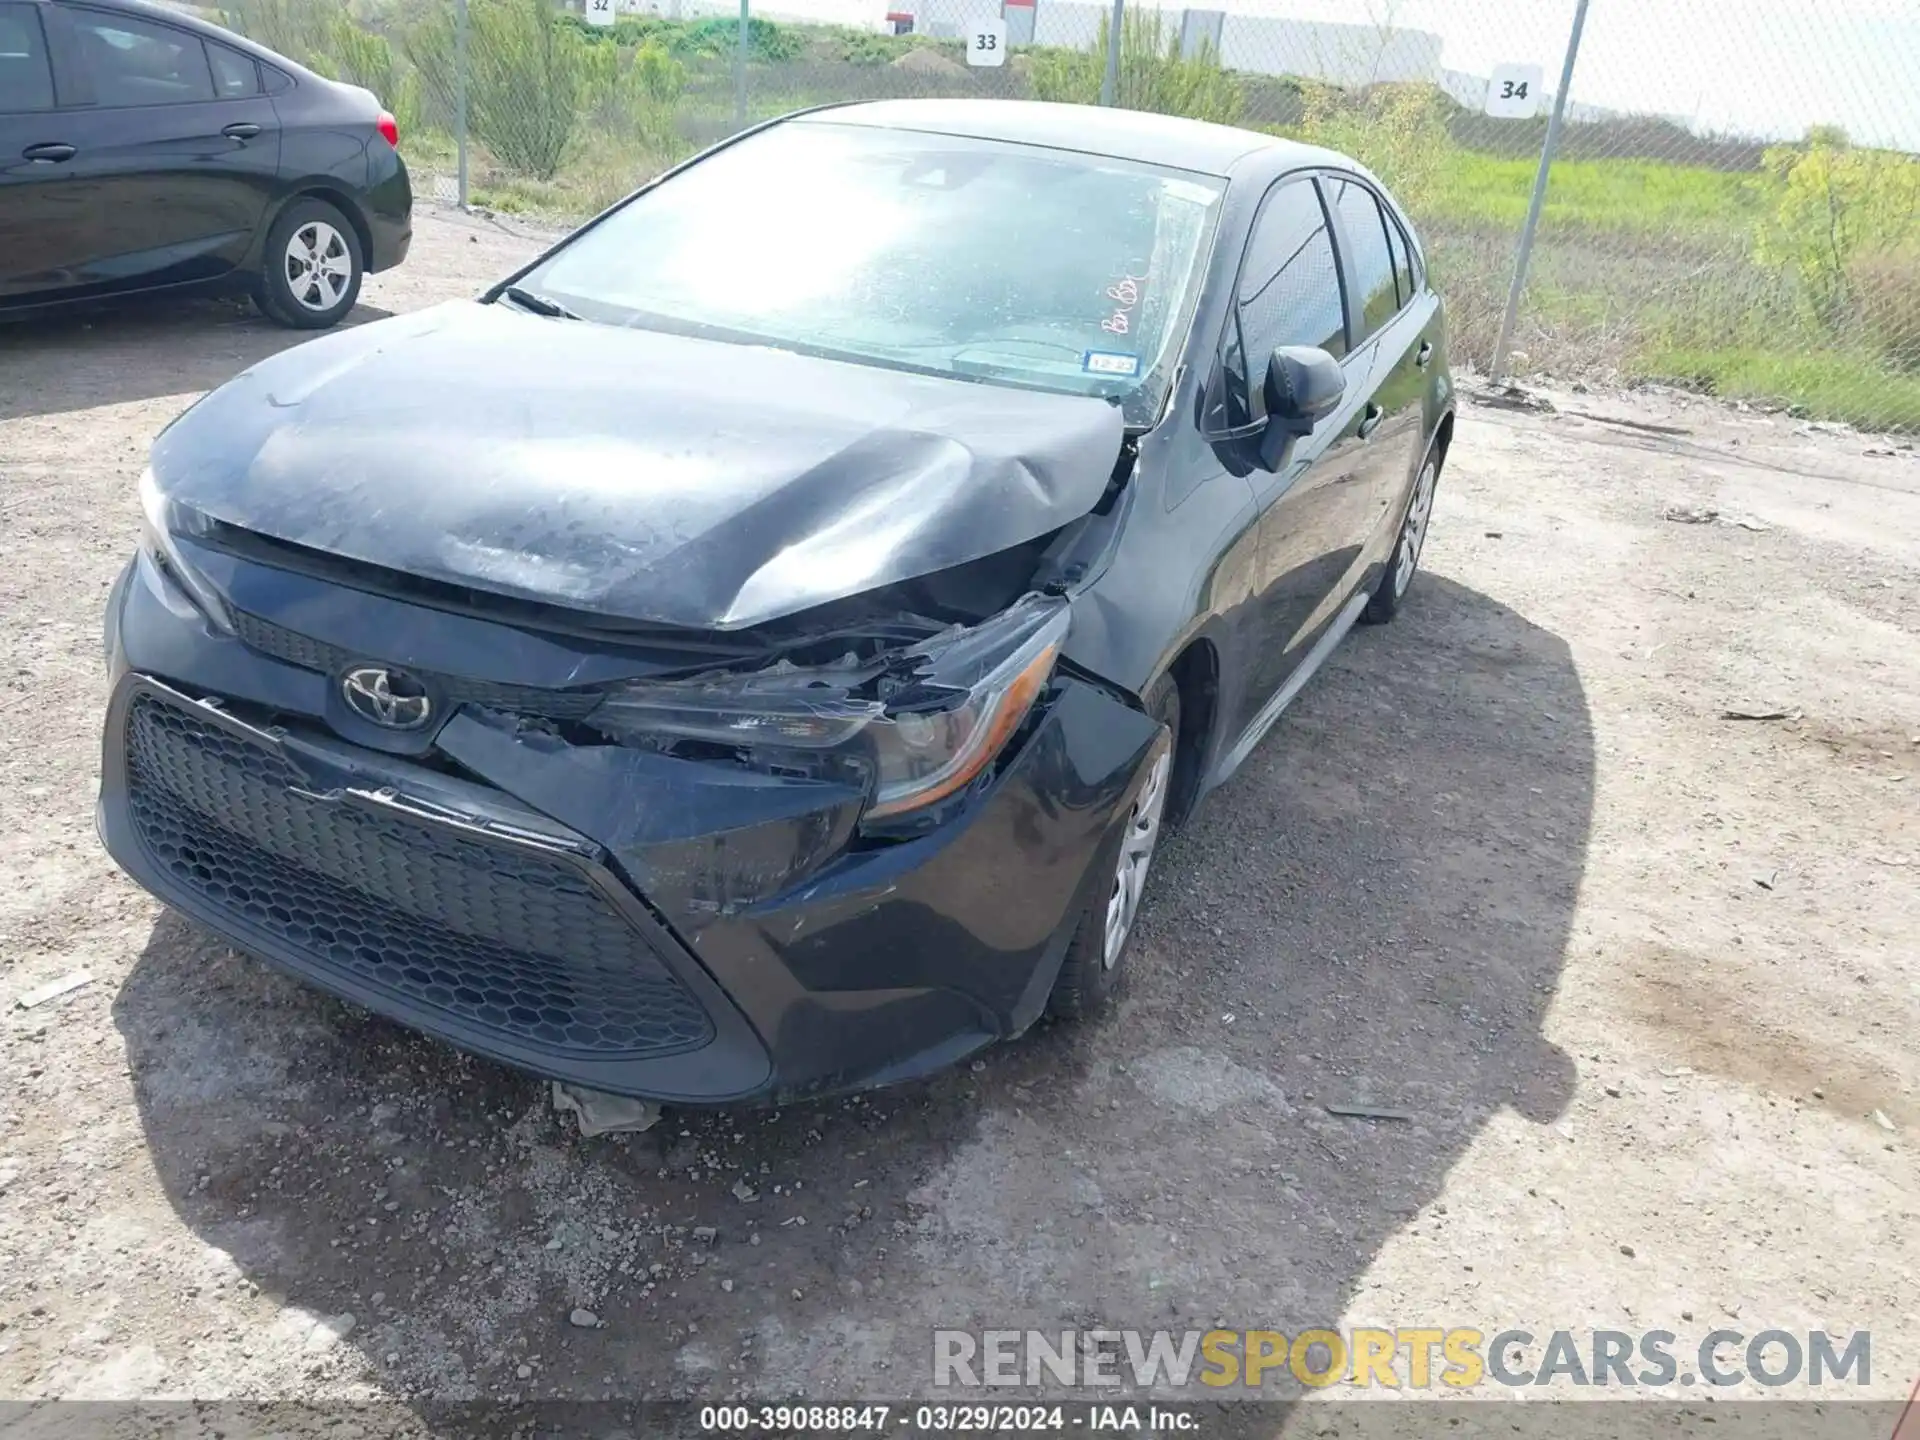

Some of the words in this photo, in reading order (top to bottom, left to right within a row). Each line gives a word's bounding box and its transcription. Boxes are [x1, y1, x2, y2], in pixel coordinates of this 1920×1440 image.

[593, 0, 608, 11] 32
[976, 34, 996, 50] 33
[1500, 81, 1528, 100] 34
